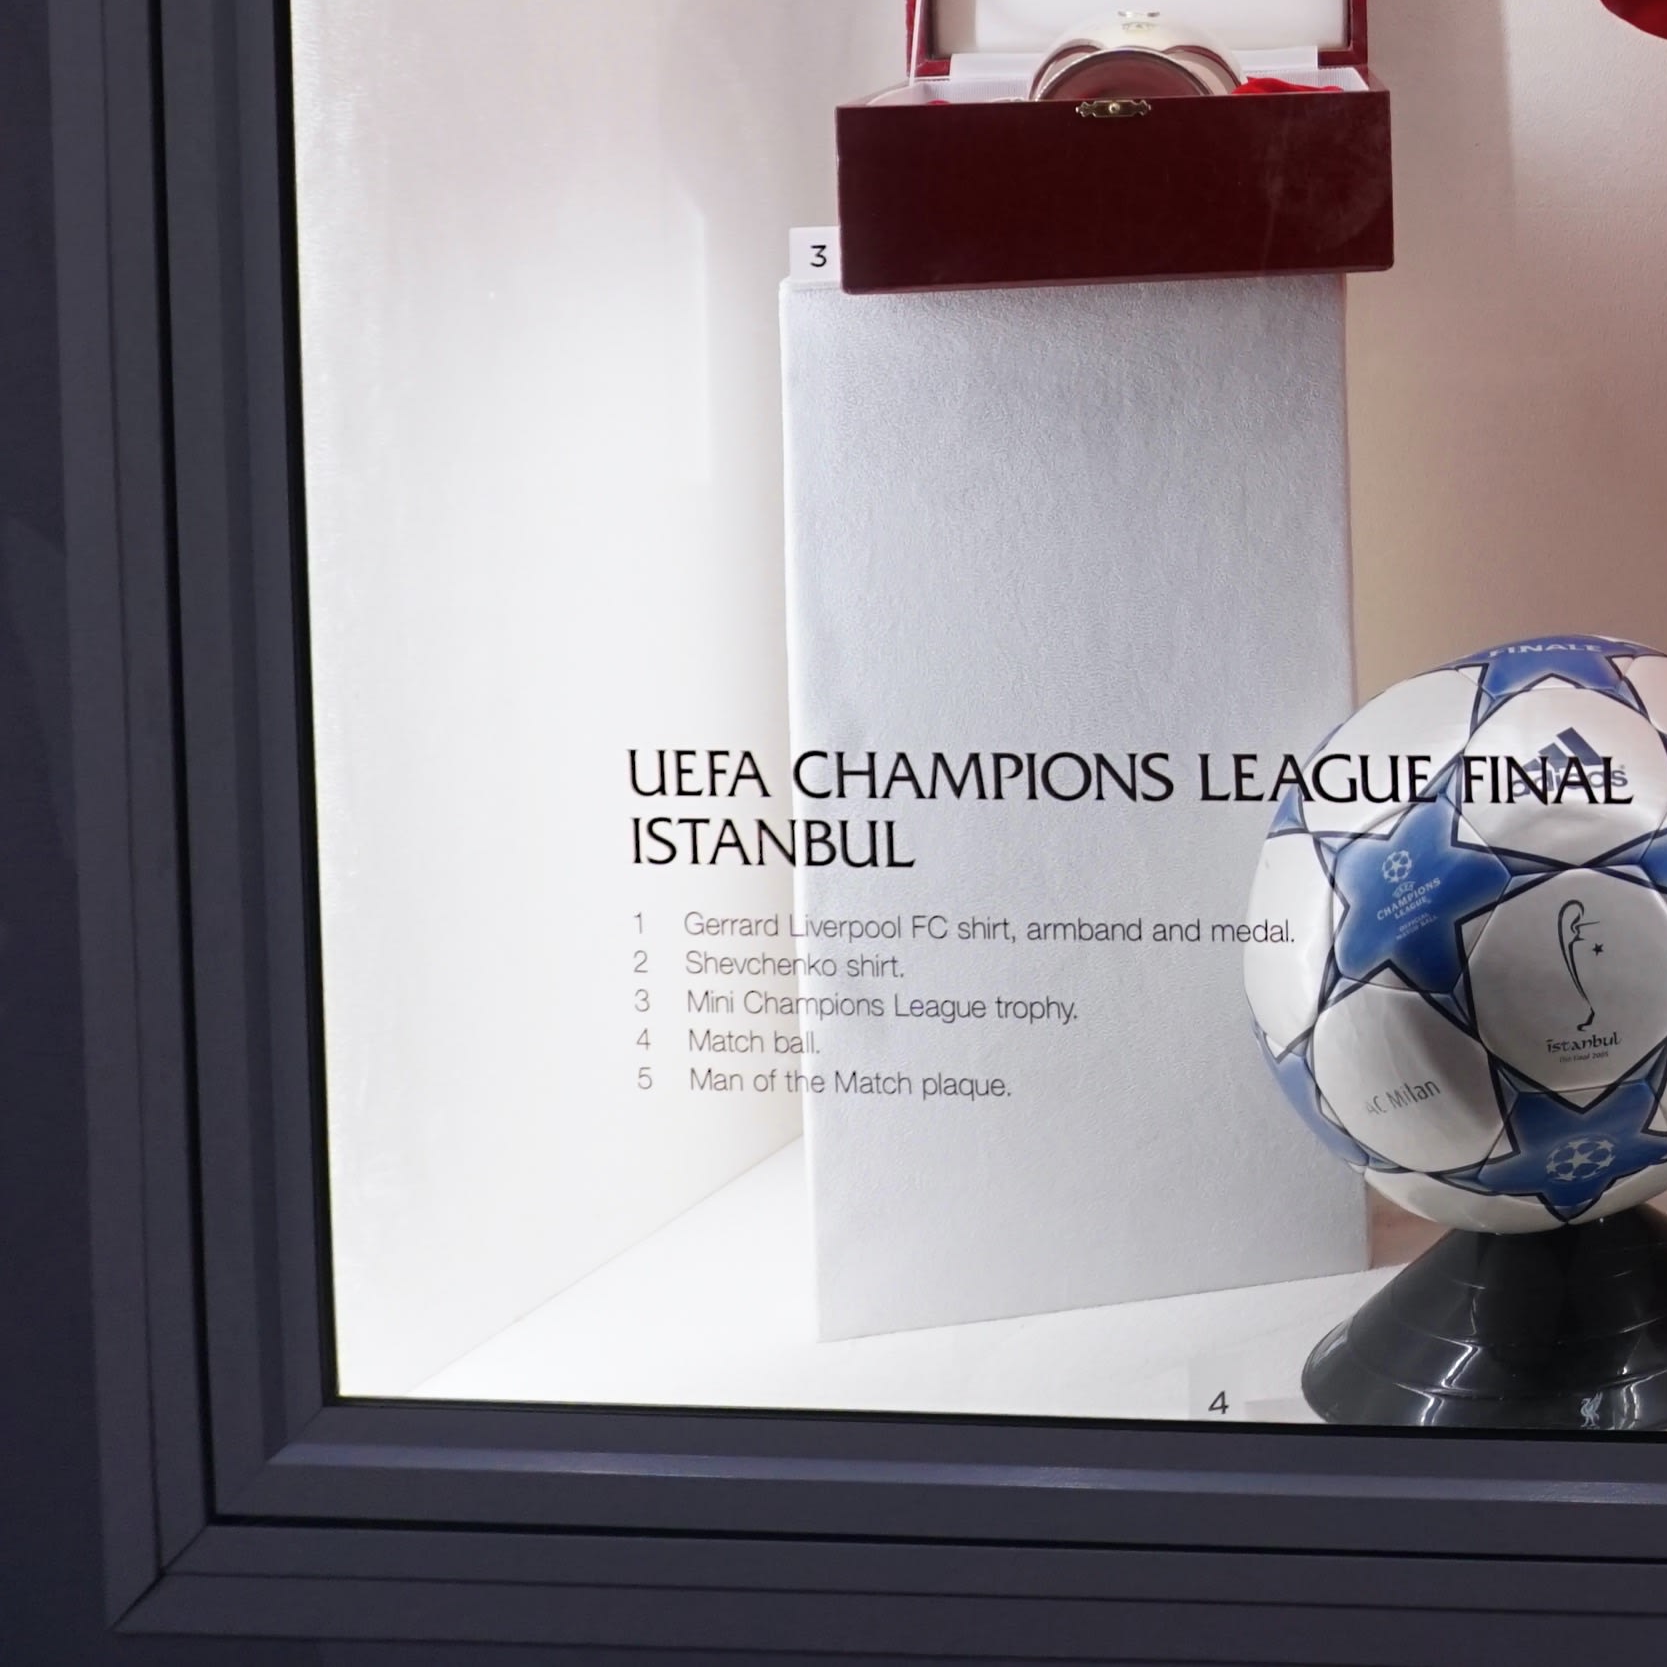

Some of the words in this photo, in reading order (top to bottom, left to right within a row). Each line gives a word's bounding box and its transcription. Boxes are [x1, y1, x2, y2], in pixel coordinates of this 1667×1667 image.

[809, 243, 828, 269] 3
[628, 748, 772, 799] UEFA
[792, 749, 1175, 803] CHAMPIONS
[1199, 751, 1441, 805] LEAGUE
[1462, 755, 1635, 806] FINAL
[632, 816, 916, 869] ISTANBUL
[1376, 877, 1442, 921] CHAMPIONS
[1395, 895, 1428, 919] LEAGUE
[633, 911, 643, 934] 1
[683, 910, 779, 938] Gerrard
[789, 913, 902, 944] Liverpool
[911, 914, 949, 940] FC
[957, 915, 1017, 944] shirt,
[1026, 916, 1143, 943] armband
[1152, 917, 1201, 943] and
[1211, 918, 1295, 944] medal.
[633, 949, 649, 974] 2
[685, 949, 838, 977] Shevchenko
[846, 953, 905, 979] shirt.
[634, 988, 651, 1013] 3
[687, 989, 734, 1013] Mini
[743, 989, 885, 1022] Champions
[894, 992, 987, 1025] League
[994, 995, 1079, 1026] trophy.
[636, 1027, 651, 1050] 4
[688, 1028, 765, 1054] Match
[773, 1029, 821, 1055] ball.
[637, 1066, 653, 1090] 5
[689, 1067, 744, 1092] Man
[752, 1068, 777, 1093] of
[783, 1069, 826, 1094] the
[834, 1069, 913, 1096] Match
[921, 1071, 1012, 1102] plaque.
[1385, 1080, 1442, 1110] Milan
[1207, 1390, 1230, 1415] 4
